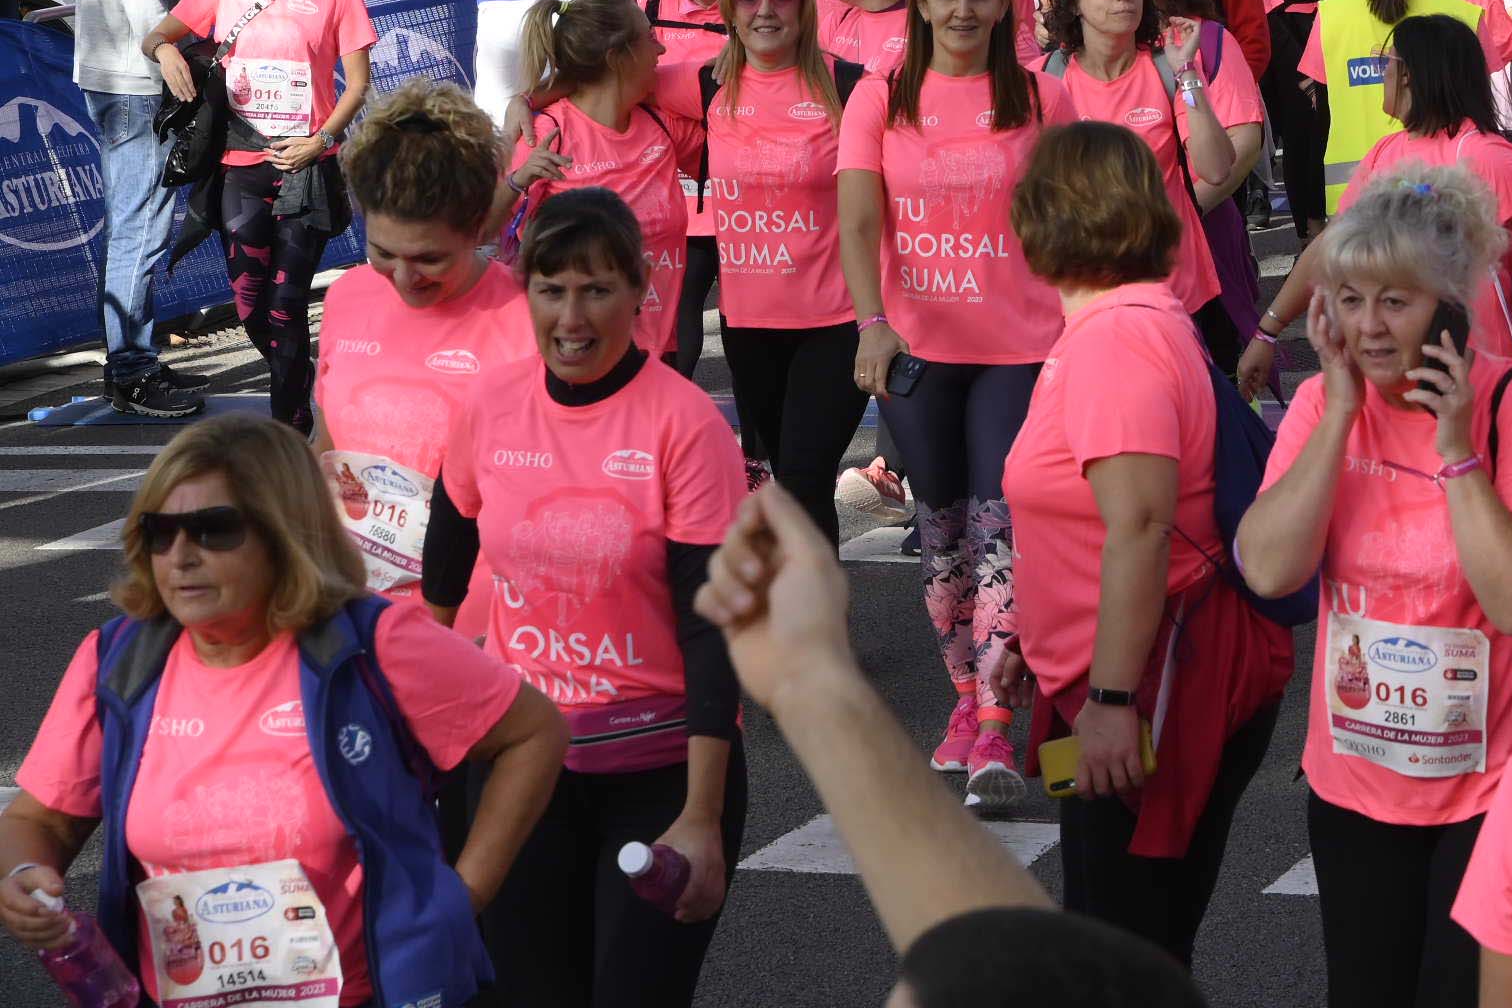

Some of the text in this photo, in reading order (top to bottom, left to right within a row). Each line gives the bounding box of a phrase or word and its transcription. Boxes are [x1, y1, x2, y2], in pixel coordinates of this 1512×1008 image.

[254, 88, 283, 100] 016
[0, 163, 105, 220] STURIANA
[712, 177, 740, 201] TU
[718, 209, 820, 233] DORSAL
[895, 196, 925, 222] TU
[719, 242, 793, 266] SUMA
[896, 231, 1009, 258] DORSAL
[900, 265, 981, 293] SUMA
[493, 449, 553, 468] OYSHO
[372, 499, 409, 528] 016
[1329, 582, 1368, 618] TU
[1370, 647, 1431, 666] ASTURIANA
[1375, 681, 1428, 708] 016
[1384, 710, 1416, 726] 2861
[1345, 721, 1383, 737] CARRERA
[1383, 729, 1397, 740] DE
[1397, 732, 1410, 742] LA
[1411, 734, 1444, 744] MUJER
[1422, 751, 1473, 765] Santander
[200, 898, 269, 916] ASTURIANA
[208, 935, 271, 966] 016
[216, 968, 267, 990] 14514
[227, 991, 243, 1004] DE
[246, 989, 260, 1002] LA
[262, 987, 296, 1000] MUJER
